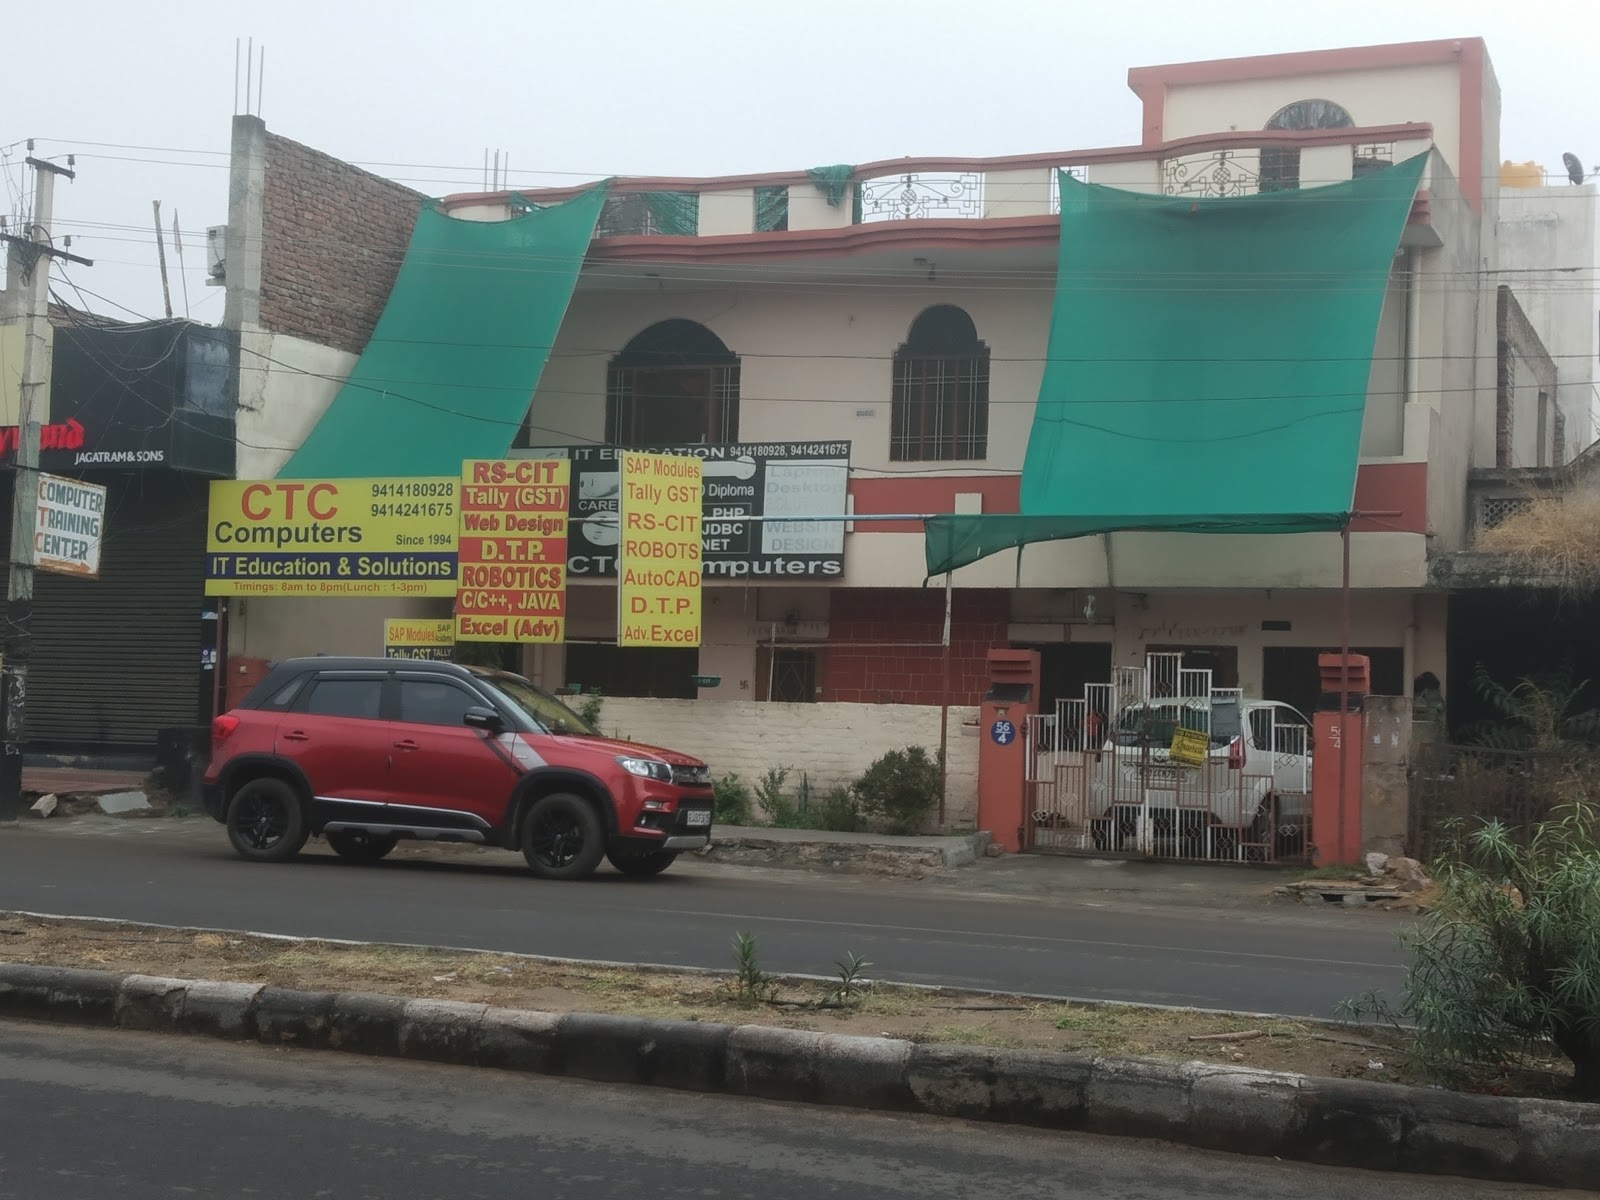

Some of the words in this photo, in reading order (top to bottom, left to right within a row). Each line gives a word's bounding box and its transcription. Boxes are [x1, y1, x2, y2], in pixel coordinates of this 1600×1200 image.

[575, 448, 593, 460] IT
[730, 446, 788, 458] 9414180928,
[790, 444, 848, 455] 9414241675
[473, 462, 559, 483] RS-CIT
[626, 457, 651, 474] SAP
[653, 458, 700, 479] Modules
[38, 481, 103, 513] COMPUTER
[371, 482, 453, 497] 9414180928
[466, 487, 509, 508] Tally
[514, 487, 565, 508] (GST)
[627, 482, 662, 505] Tally
[667, 485, 699, 503] GST
[708, 483, 755, 499] Diploma
[240, 483, 339, 520] CTC
[371, 503, 453, 517] 9414241675
[38, 506, 99, 538] TRAINING
[627, 512, 698, 532] RS-CIT
[713, 507, 745, 518] PHP
[215, 521, 363, 549] Computers
[464, 514, 500, 531] Web
[505, 514, 564, 536] Design
[34, 532, 88, 561] CENTER
[396, 534, 424, 546] Since
[428, 534, 452, 546] 1994
[625, 540, 699, 560] ROBOTS
[480, 540, 546, 561] D.T.P.
[213, 557, 230, 576] IT
[235, 557, 331, 576] Education
[337, 558, 351, 576] &
[358, 557, 452, 576] Solutions
[462, 566, 561, 588] ROBOTICS
[624, 569, 700, 588] AutoCAD
[234, 582, 279, 593] Timings:
[281, 583, 301, 592] 8am
[306, 583, 317, 592] to
[391, 583, 428, 594] 1-3pm)
[461, 591, 513, 613] C/C++,
[517, 593, 561, 610] JAVA
[631, 597, 695, 616] D.T.P.
[389, 627, 405, 641] SAP
[406, 627, 435, 642] Modules
[437, 624, 451, 632] SAP
[460, 618, 509, 636] Excel
[513, 620, 560, 640] (Adv)
[433, 648, 452, 657] TALLY
[996, 721, 1010, 732] 56
[997, 733, 1007, 744] 4
